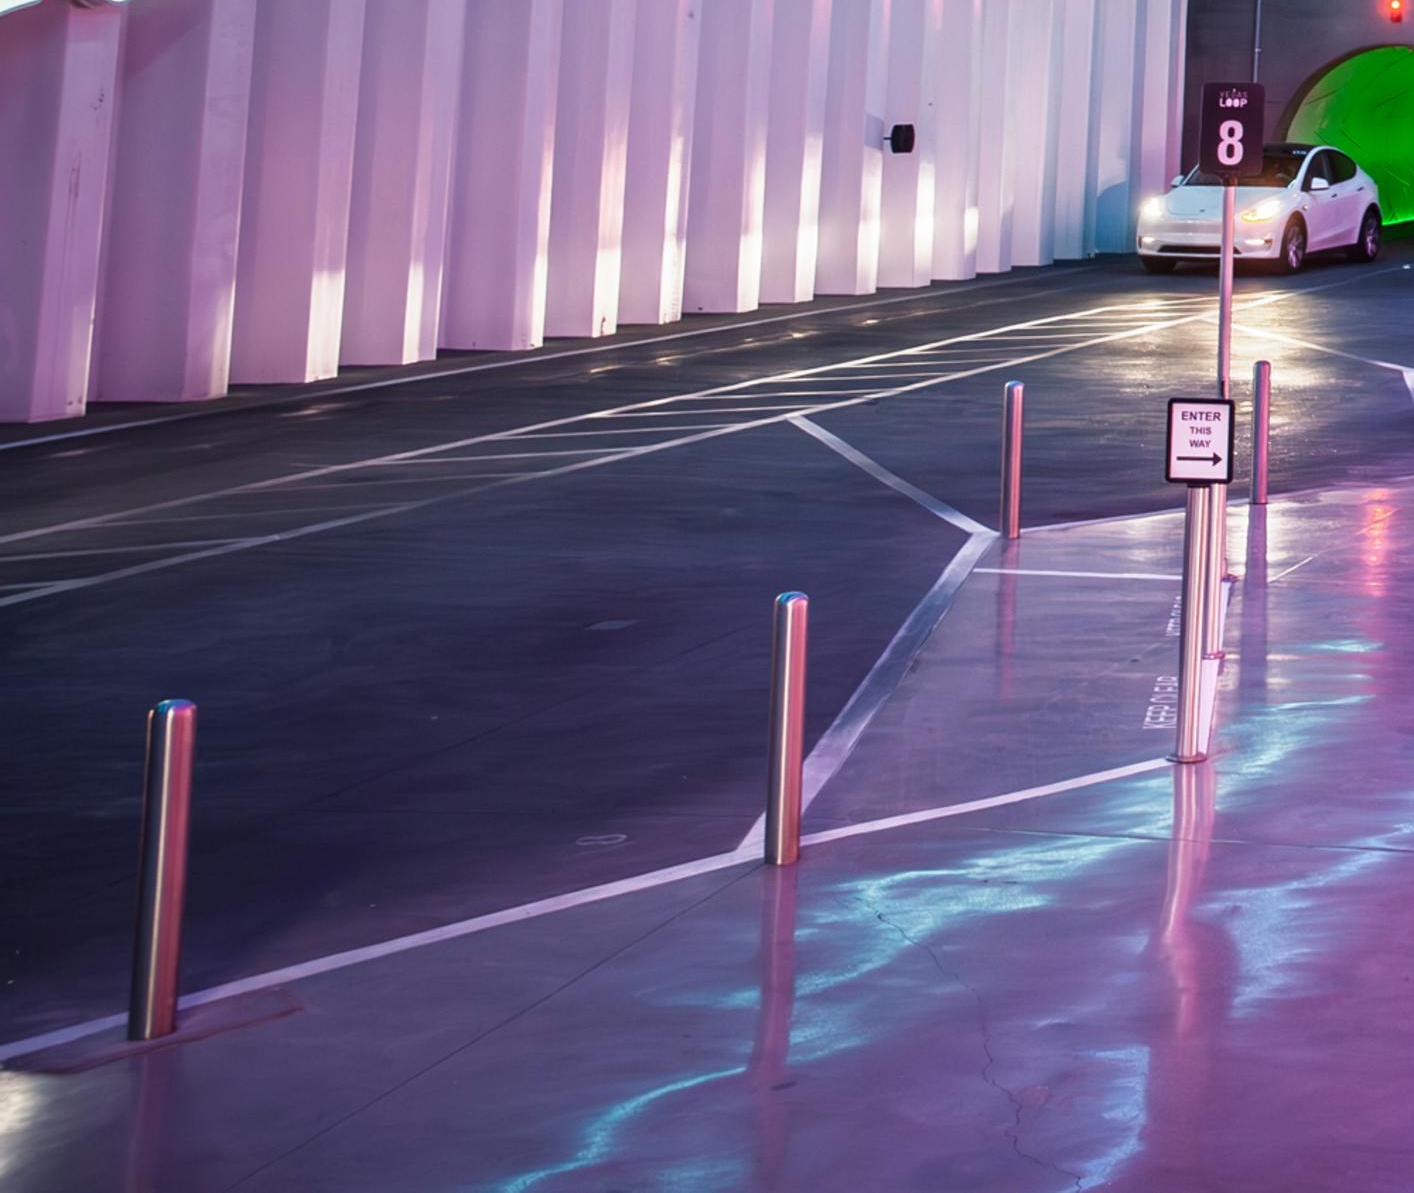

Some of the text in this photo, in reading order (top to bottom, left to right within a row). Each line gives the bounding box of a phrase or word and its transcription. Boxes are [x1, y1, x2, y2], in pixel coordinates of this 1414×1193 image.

[1219, 98, 1248, 108] LOOP
[1217, 119, 1244, 166] 8
[1181, 411, 1221, 421] ENTER
[1190, 427, 1212, 435] THIS
[1189, 439, 1211, 447] WAY
